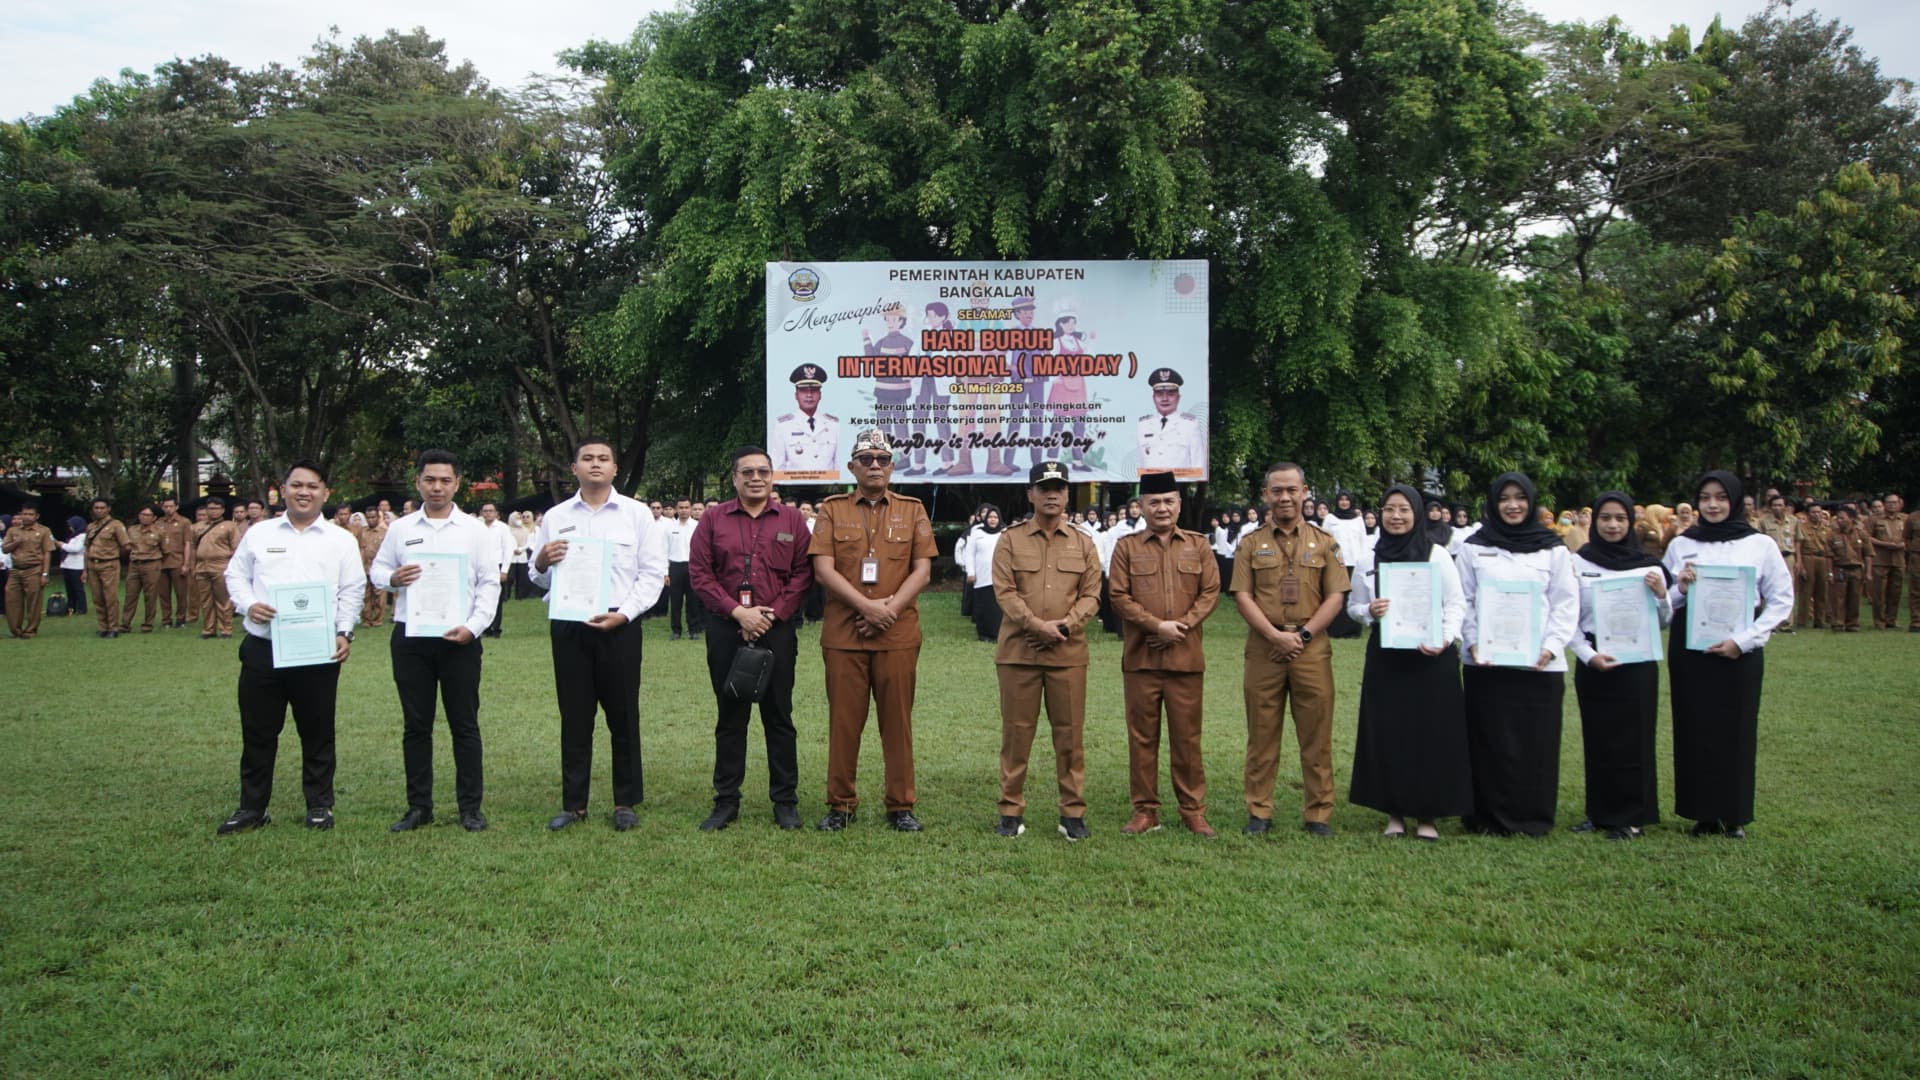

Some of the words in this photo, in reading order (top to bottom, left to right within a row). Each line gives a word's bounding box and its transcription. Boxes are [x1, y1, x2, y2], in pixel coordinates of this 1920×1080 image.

[889, 269, 989, 281] PEMERINTAH
[994, 268, 1085, 280] KABUPATEN
[939, 286, 1035, 298] BANGKALAN
[783, 297, 901, 332] Mengucapkan
[957, 309, 1014, 321] SELAMAT
[921, 329, 976, 351] HARI
[980, 328, 1054, 350] BURUH
[837, 355, 1011, 377] INTERNASIONAL
[949, 383, 966, 393] 01
[967, 383, 990, 393] Mei
[993, 383, 1024, 393] 2025
[874, 403, 917, 413] Merajut
[919, 403, 996, 411] Kebersamaan
[998, 402, 1030, 410] untuk
[1033, 402, 1102, 412] Peningkatan
[934, 416, 975, 425] Pekerja
[977, 415, 997, 423] dan
[1000, 415, 1077, 424] Produktivitas
[1080, 414, 1125, 423] Nasional
[950, 432, 963, 448] is
[968, 431, 1061, 449] Kolaborasi
